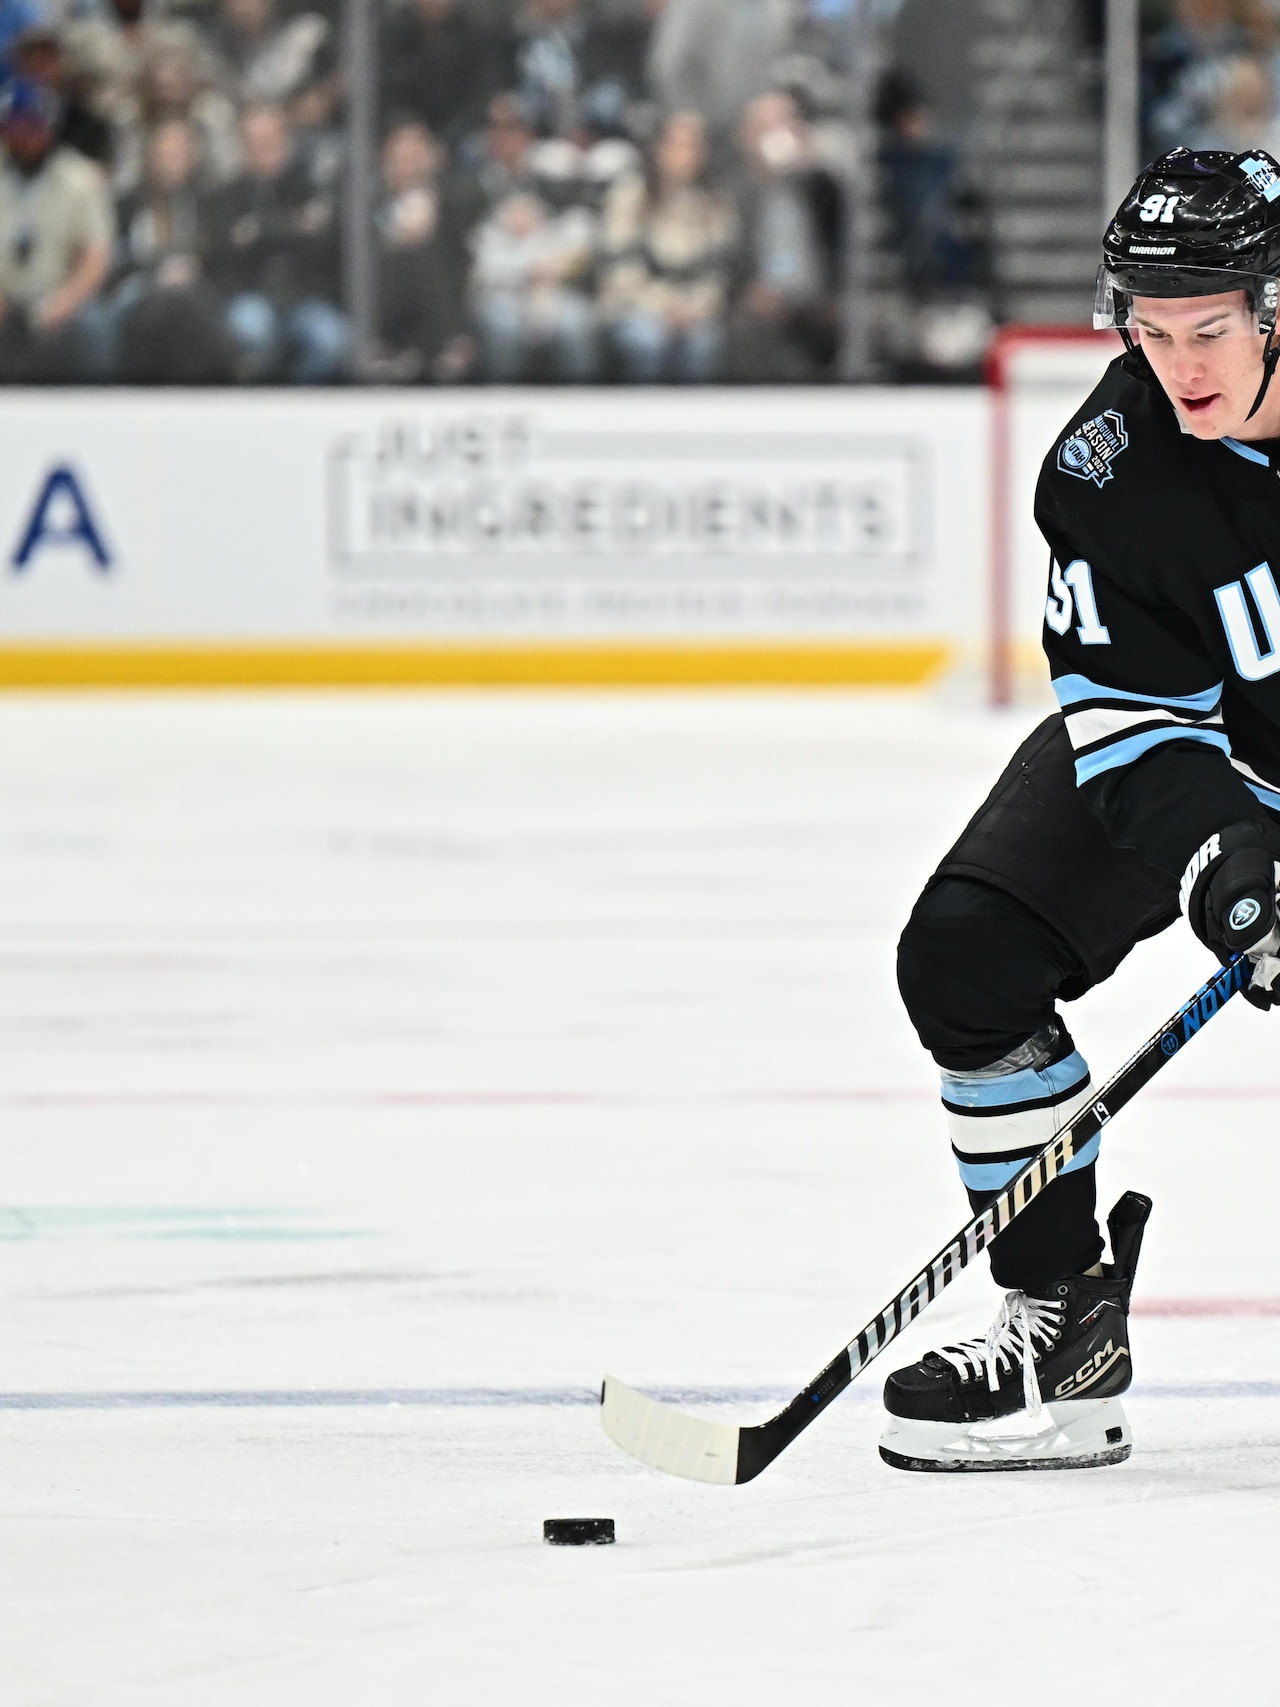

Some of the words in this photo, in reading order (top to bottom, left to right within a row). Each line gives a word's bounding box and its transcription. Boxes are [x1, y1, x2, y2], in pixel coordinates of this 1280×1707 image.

[1139, 194, 1180, 224] 91
[1128, 245, 1177, 256] WARRIOR
[1068, 442, 1086, 464] UTAH
[1091, 455, 1106, 474] 2025
[847, 1129, 1074, 1381] WARRIOR
[1055, 1339, 1114, 1397] CCM
